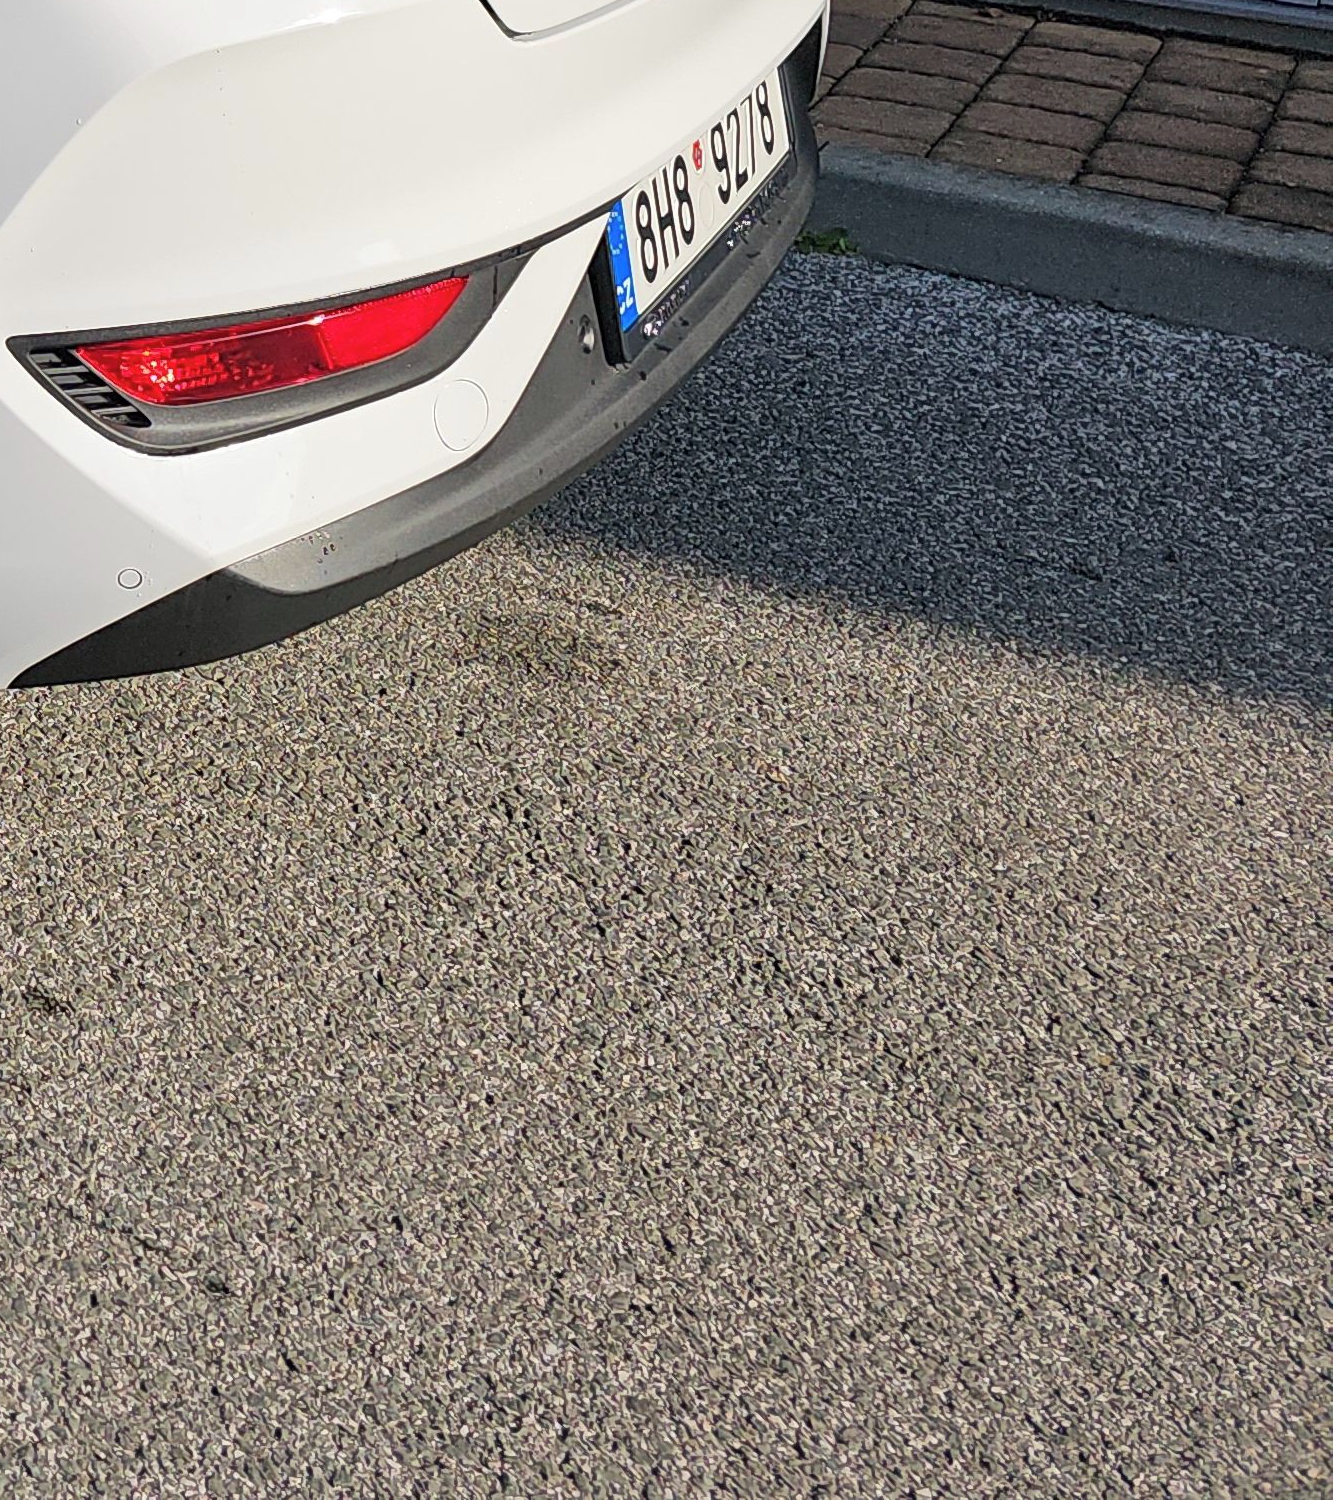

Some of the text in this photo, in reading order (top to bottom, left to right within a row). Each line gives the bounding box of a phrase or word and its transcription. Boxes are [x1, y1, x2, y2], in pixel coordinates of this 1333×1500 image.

[635, 154, 695, 283] 8H8
[709, 80, 775, 205] 9278
[617, 276, 634, 316] CZ
